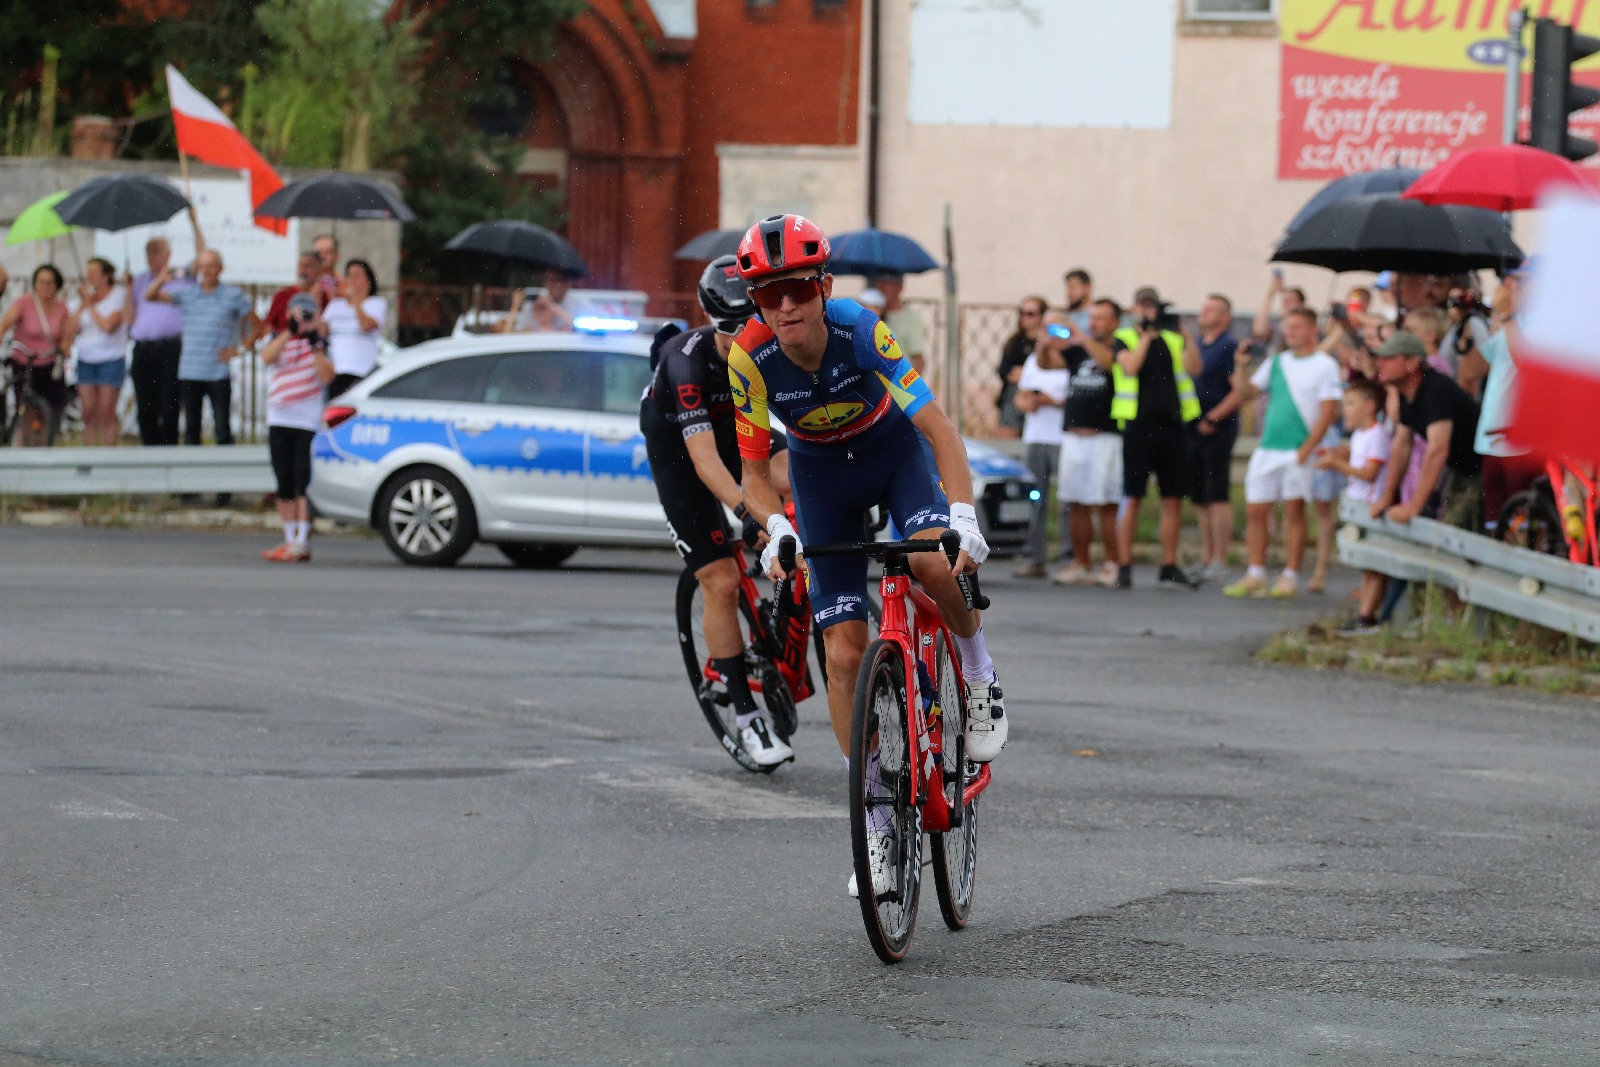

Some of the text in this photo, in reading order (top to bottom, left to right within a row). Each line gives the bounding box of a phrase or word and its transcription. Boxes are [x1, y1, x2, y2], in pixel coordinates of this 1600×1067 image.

[1291, 64, 1399, 100] wesela
[1303, 99, 1488, 146] konferencje
[754, 341, 779, 365] TREK
[829, 375, 862, 393] SRAM
[775, 389, 812, 402] Santini
[913, 513, 949, 526] TR
